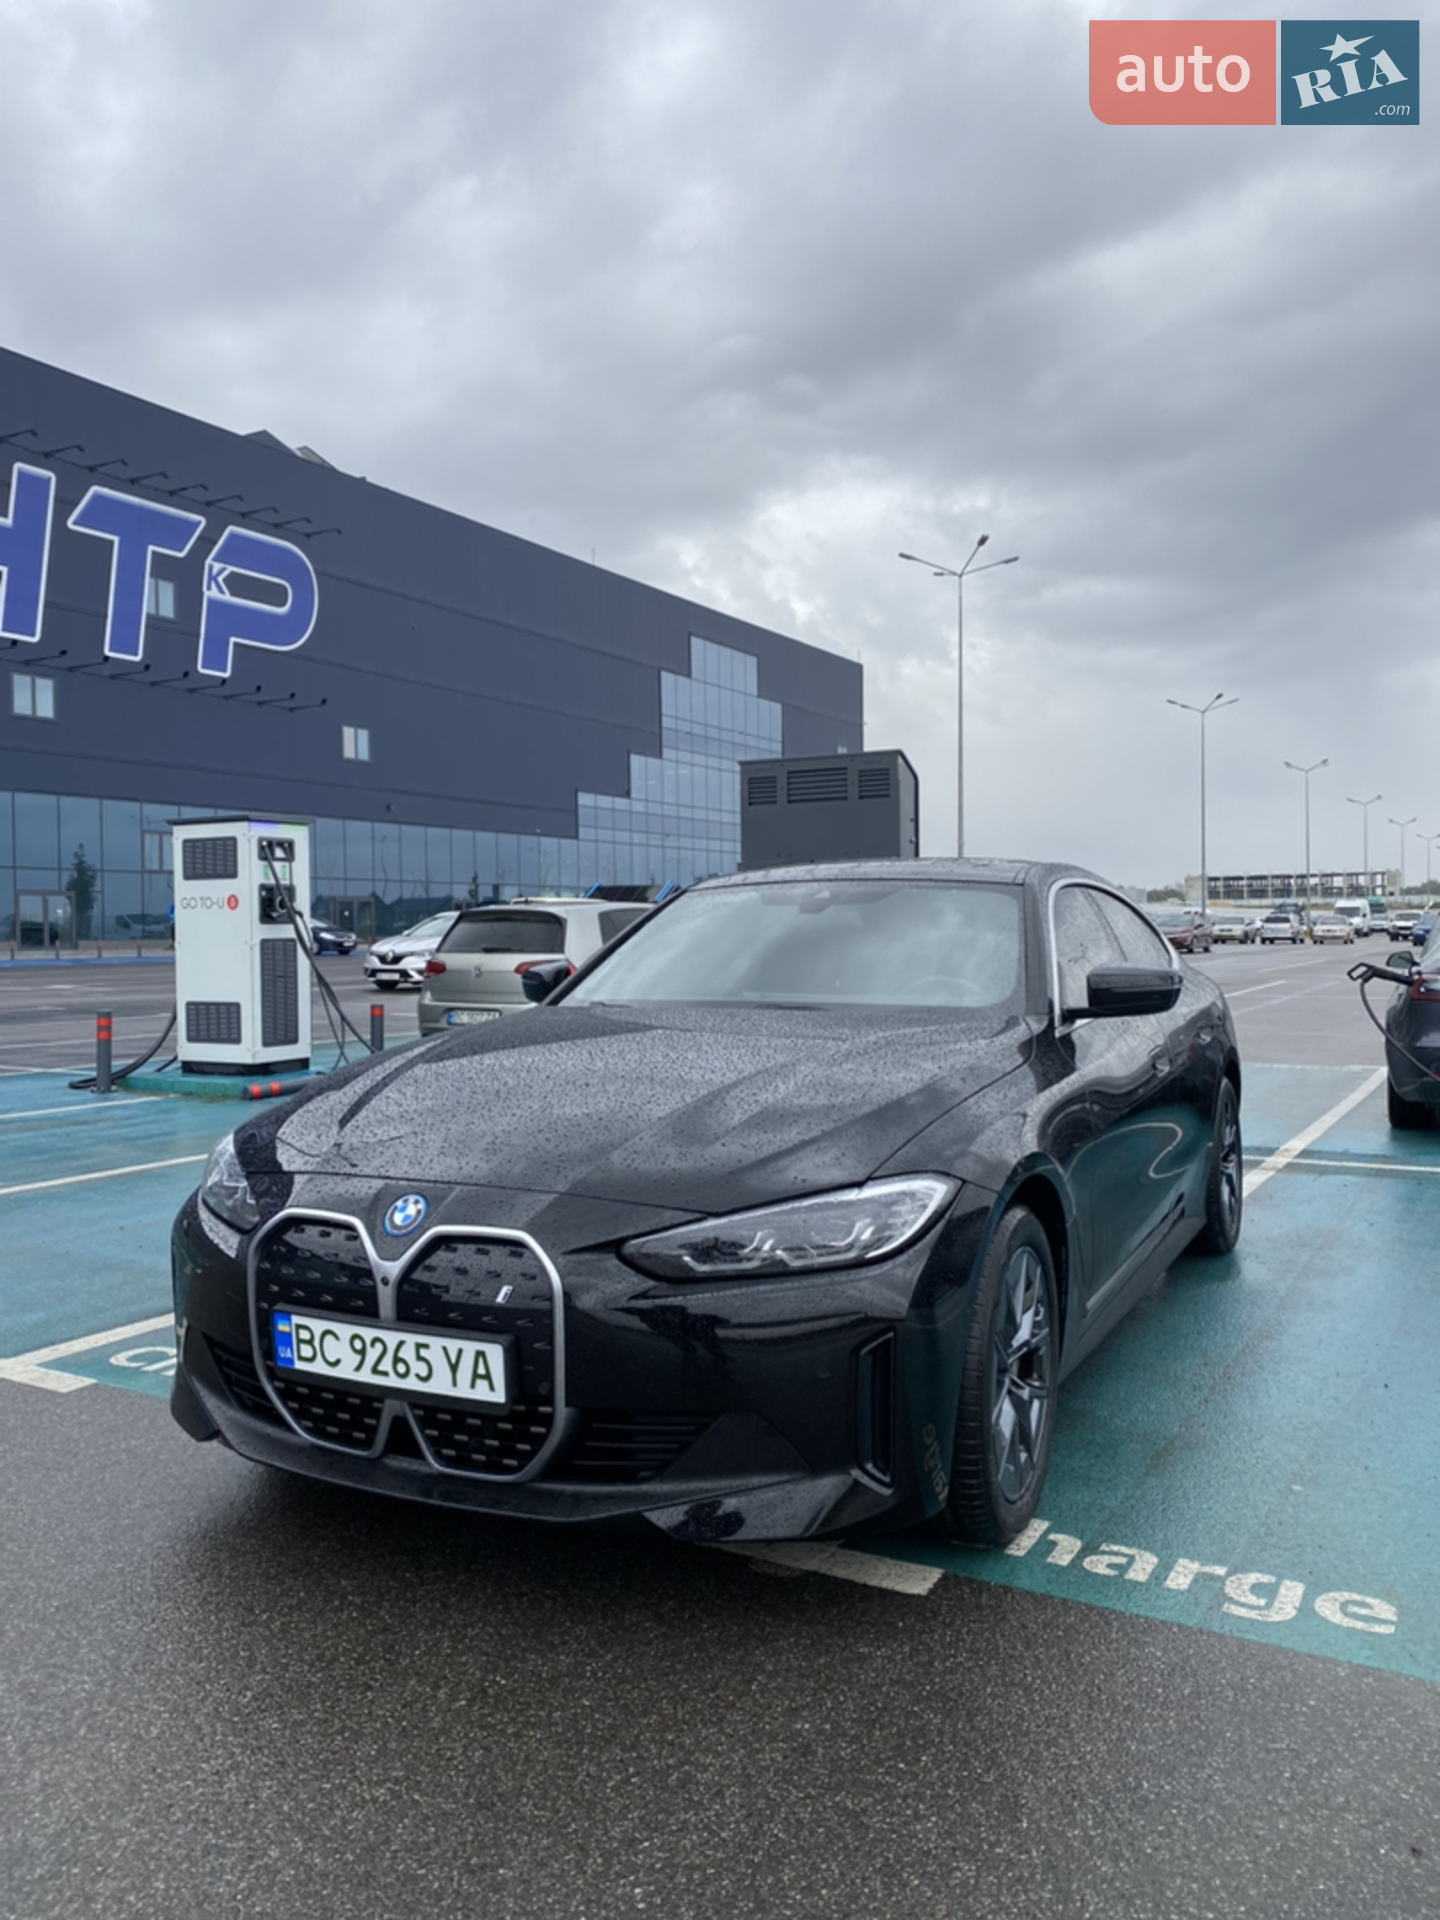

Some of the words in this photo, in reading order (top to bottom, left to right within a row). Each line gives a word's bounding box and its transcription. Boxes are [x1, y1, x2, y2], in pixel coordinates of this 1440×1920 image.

[180, 897, 198, 910] GO
[278, 1345, 294, 1359] UA
[294, 1323, 342, 1368] BC
[348, 1333, 434, 1383] 9265
[441, 1345, 496, 1393] YA
[1004, 1518, 1399, 1635] harge
